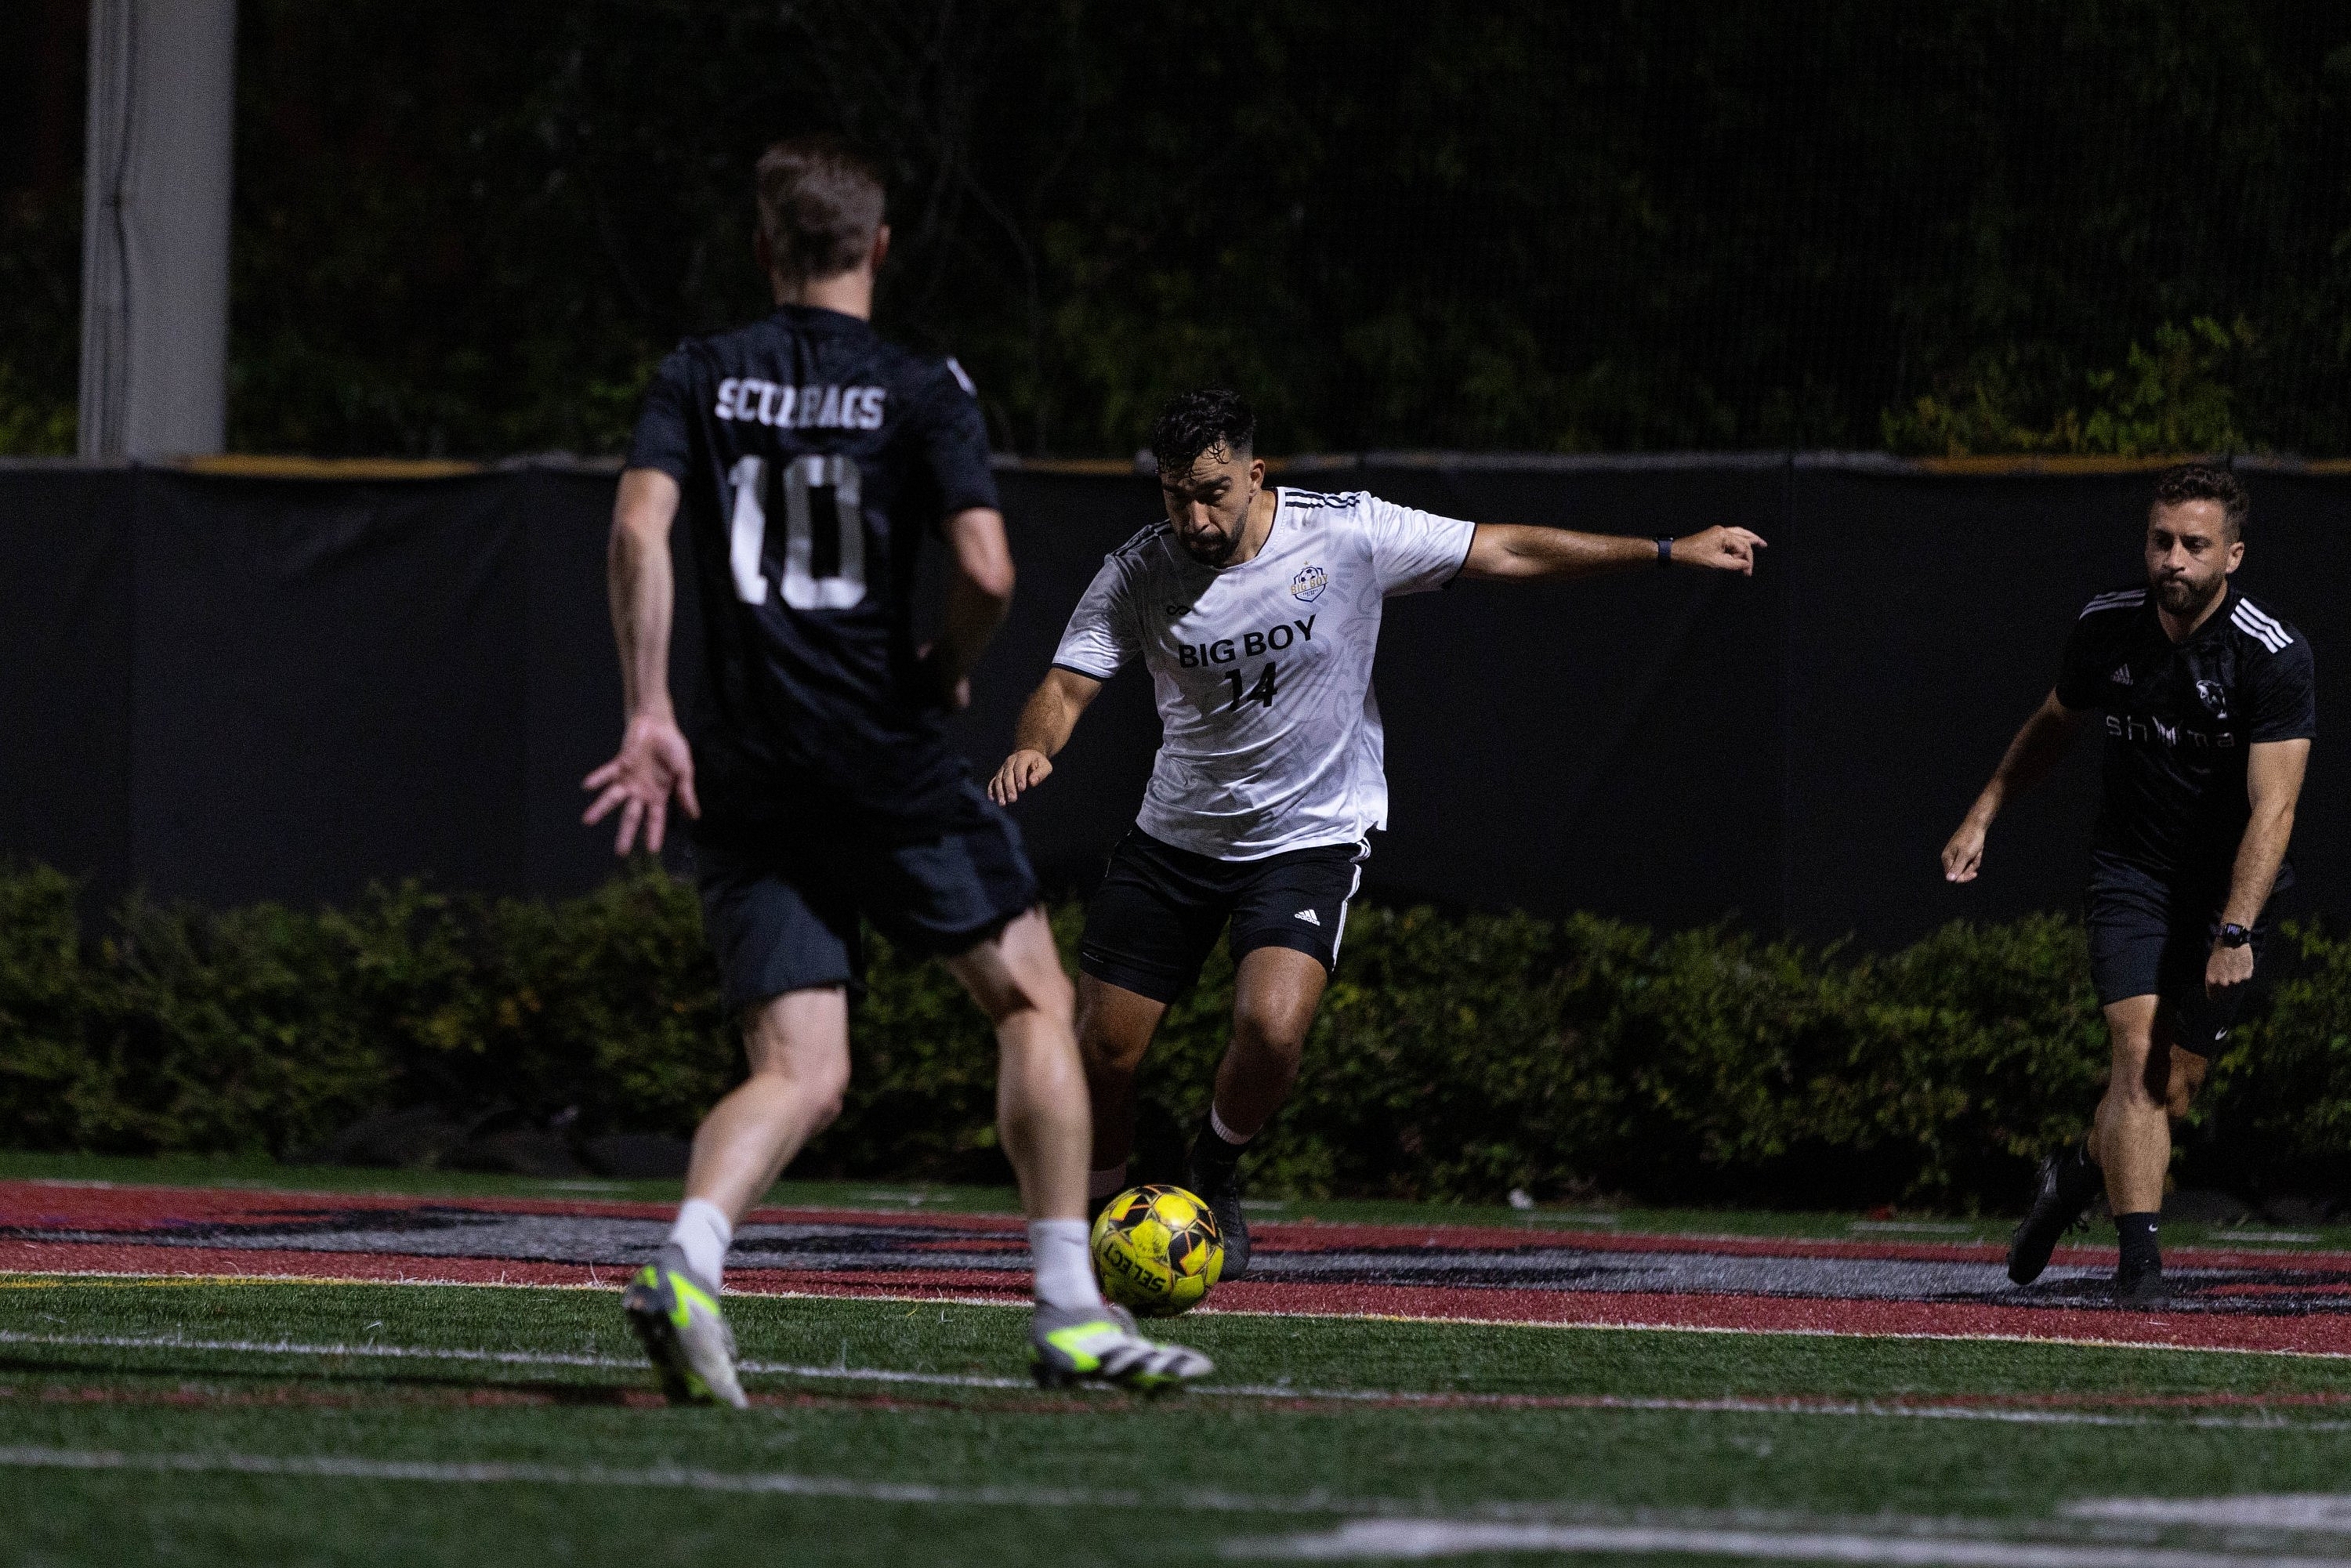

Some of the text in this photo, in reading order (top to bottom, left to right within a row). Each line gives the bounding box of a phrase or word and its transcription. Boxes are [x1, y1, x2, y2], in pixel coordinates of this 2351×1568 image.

[729, 454, 867, 610] 10
[1291, 582, 1308, 594] BIG
[1310, 574, 1328, 588] BOY
[1179, 614, 1317, 668] BIG BOY
[1225, 661, 1277, 712] 14
[1102, 1243, 1166, 1292] SELECT
